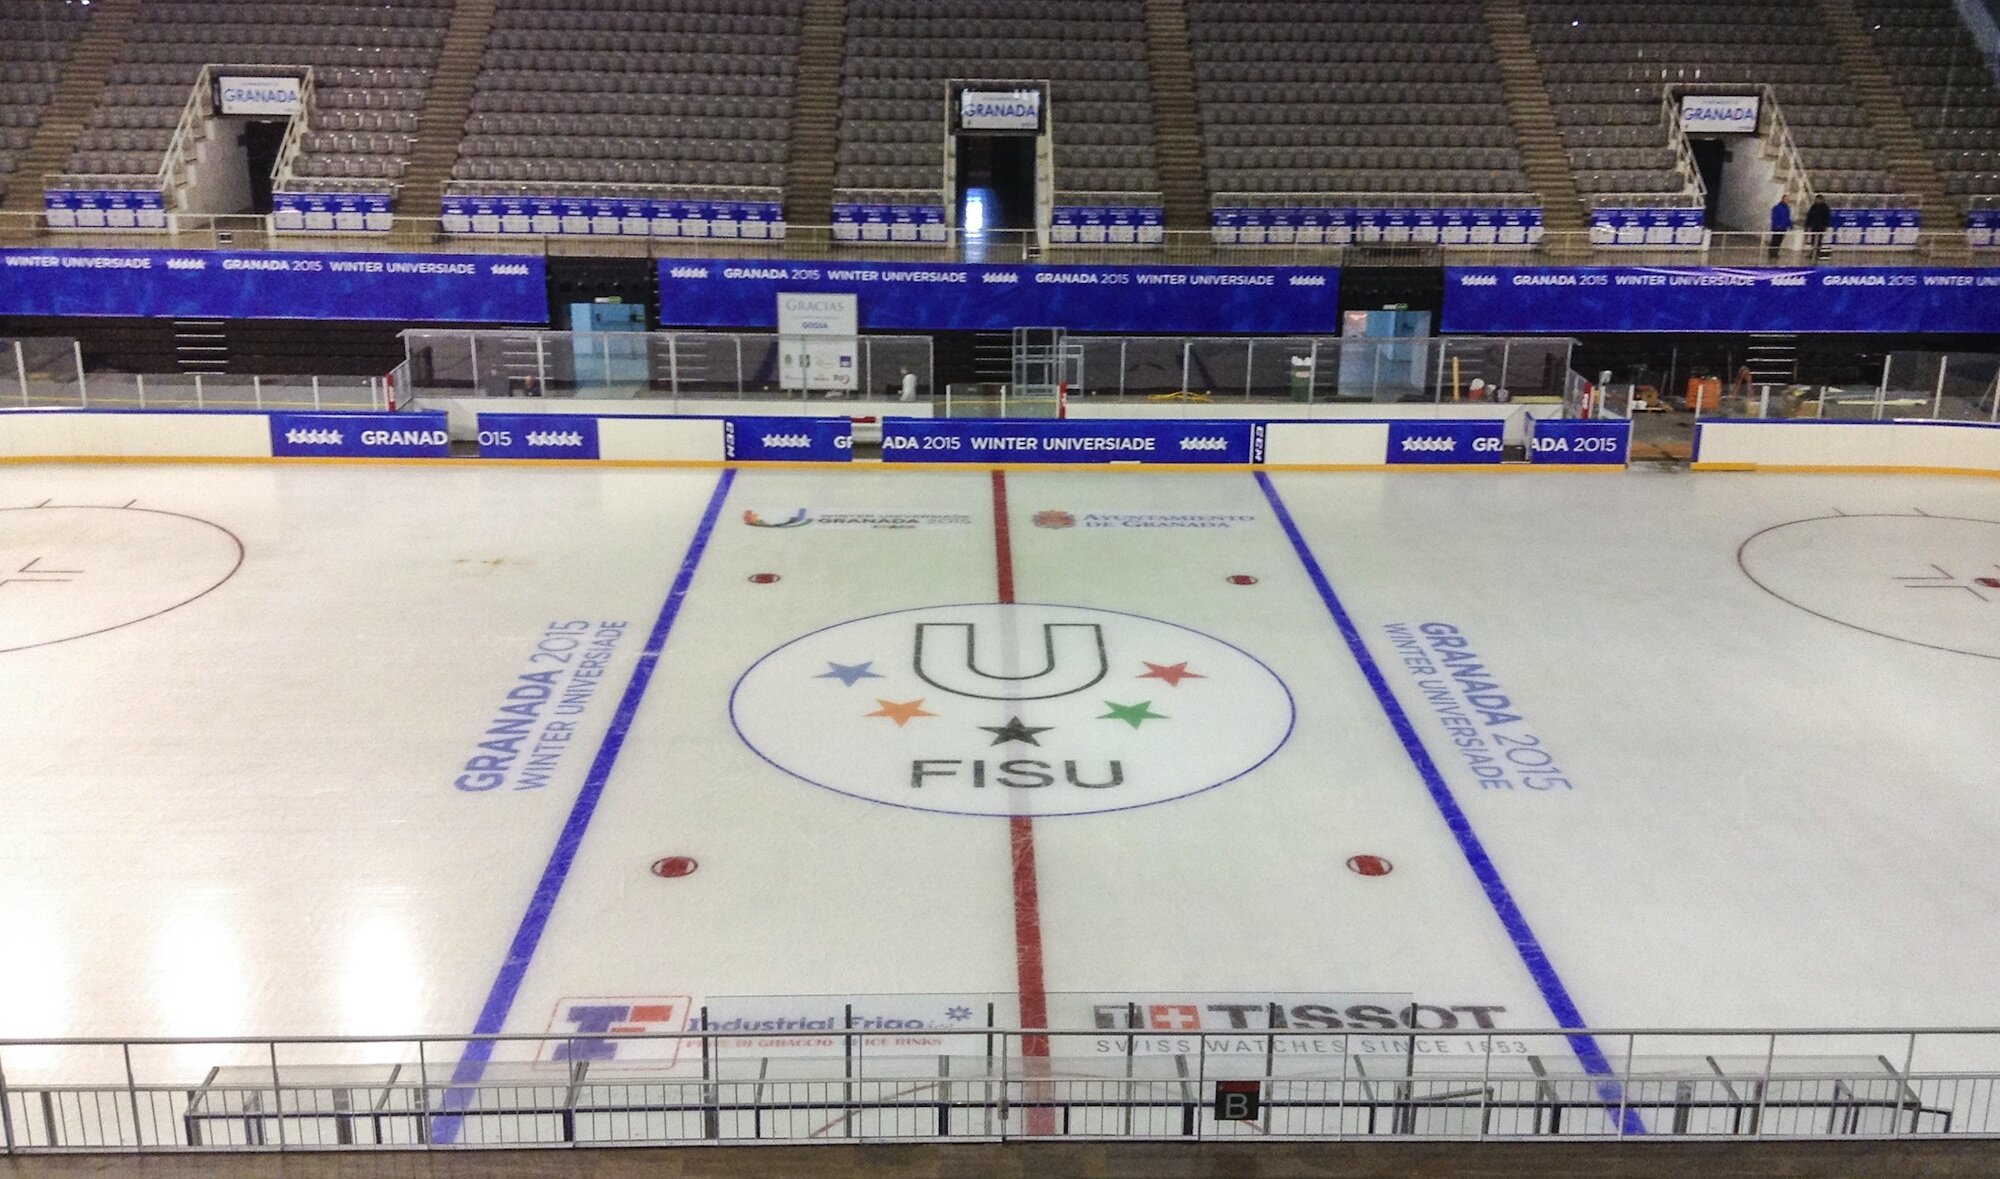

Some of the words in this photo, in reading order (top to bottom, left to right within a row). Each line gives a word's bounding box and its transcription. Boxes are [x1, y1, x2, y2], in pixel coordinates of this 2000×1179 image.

[224, 88, 298, 102] GRANADA
[963, 103, 1036, 117] GRANADA
[1682, 107, 1754, 120] GRANADA
[5, 256, 60, 267] WINTER
[62, 257, 152, 269] UNIVERSIADE
[222, 259, 290, 271] GRANADA
[292, 260, 323, 272] 2015
[329, 261, 383, 273] WINTER
[386, 262, 476, 275] UNIVERSIADE
[723, 268, 788, 280] GRANADA
[791, 269, 820, 281] 2015
[827, 269, 879, 282] WINTER
[882, 271, 967, 284] UNIVERSIADE
[1035, 273, 1098, 285] GRANADA
[1101, 274, 1129, 285] 2015
[1136, 274, 1187, 286] WINTER
[1190, 274, 1275, 287] UNIVERSIADE
[1512, 275, 1577, 286] GRANADA
[1579, 275, 1608, 286] 2015
[1615, 275, 1666, 287] WINTER
[1669, 275, 1756, 287] UNIVERSIADE
[1822, 275, 1886, 287] GRANADA
[1887, 275, 1917, 287] 2015
[1923, 275, 1974, 287] WINTER
[1976, 276, 2000, 287] UNI
[785, 299, 844, 312] GRACIAS
[361, 430, 448, 446] GRANAD
[478, 431, 512, 446] 015
[923, 436, 961, 450] 2015
[970, 437, 1038, 450] WINTER
[1043, 437, 1156, 451] UNIVERSIADE
[1573, 437, 1617, 452] 2015
[454, 669, 564, 792] GRANADA
[529, 620, 590, 664] 2015
[513, 720, 577, 791] WINTER
[554, 620, 628, 715] UNIVERSIADE
[1383, 622, 1437, 675] WINTER
[1417, 679, 1513, 790] UNIVERSIADE
[1419, 622, 1523, 726] GRANADA
[1492, 733, 1573, 791] 2015
[910, 759, 1124, 789] FISU
[688, 1016, 835, 1031] Industrial
[1207, 1004, 1506, 1029] TISSOT
[1097, 1039, 1191, 1053] SWISS
[1205, 1039, 1345, 1053] WATCHES
[1361, 1040, 1449, 1053] SINCE
[1467, 1040, 1527, 1053] 1853
[1225, 1092, 1249, 1120] B
